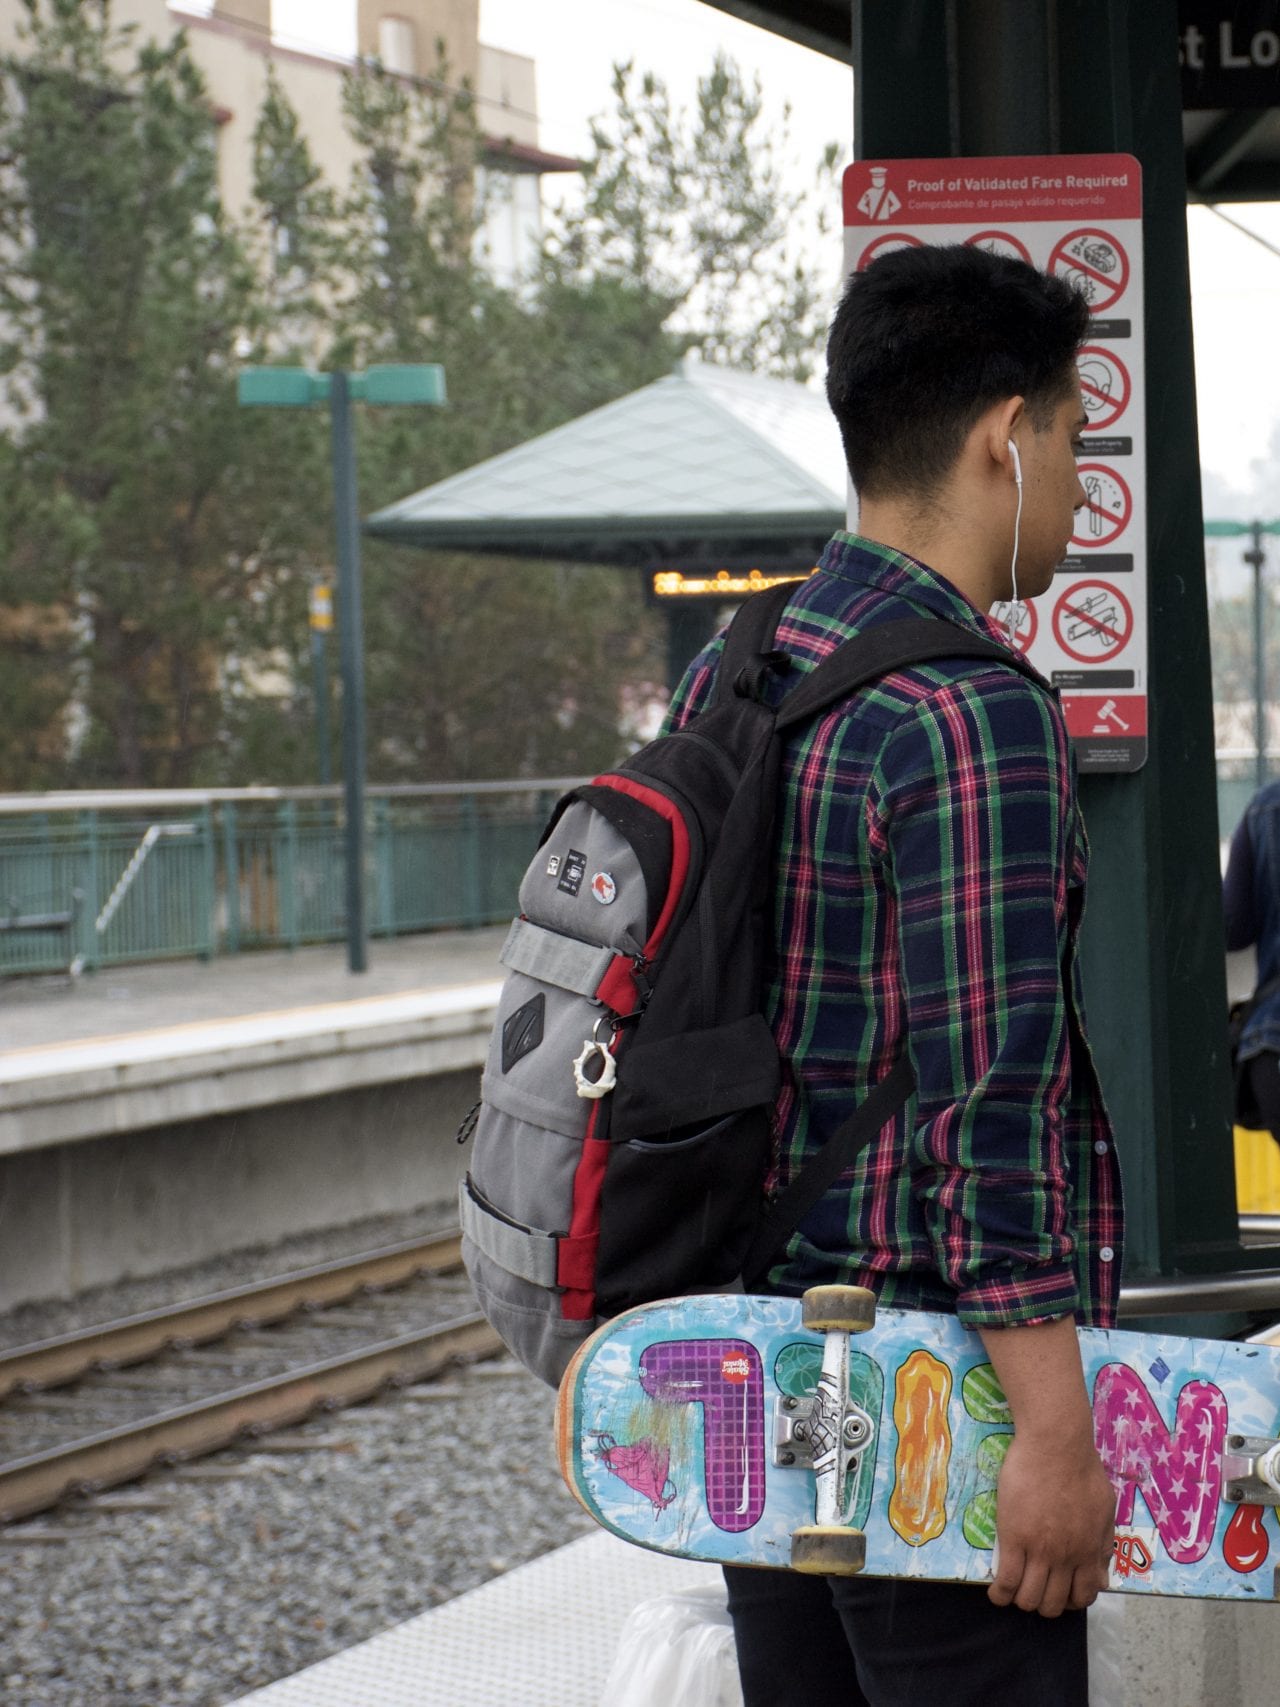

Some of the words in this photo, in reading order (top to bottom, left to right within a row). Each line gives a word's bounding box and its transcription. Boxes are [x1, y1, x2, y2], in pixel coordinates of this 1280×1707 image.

[1178, 24, 1204, 69] t
[907, 179, 945, 192] Proof
[948, 178, 961, 191] of
[965, 177, 1028, 191] Validated
[1032, 176, 1062, 189] Fare
[1066, 174, 1128, 190] Required
[908, 199, 975, 210] Comprobante
[977, 199, 989, 208] de
[991, 198, 1023, 209] pasaje
[1057, 195, 1106, 208] requerido
